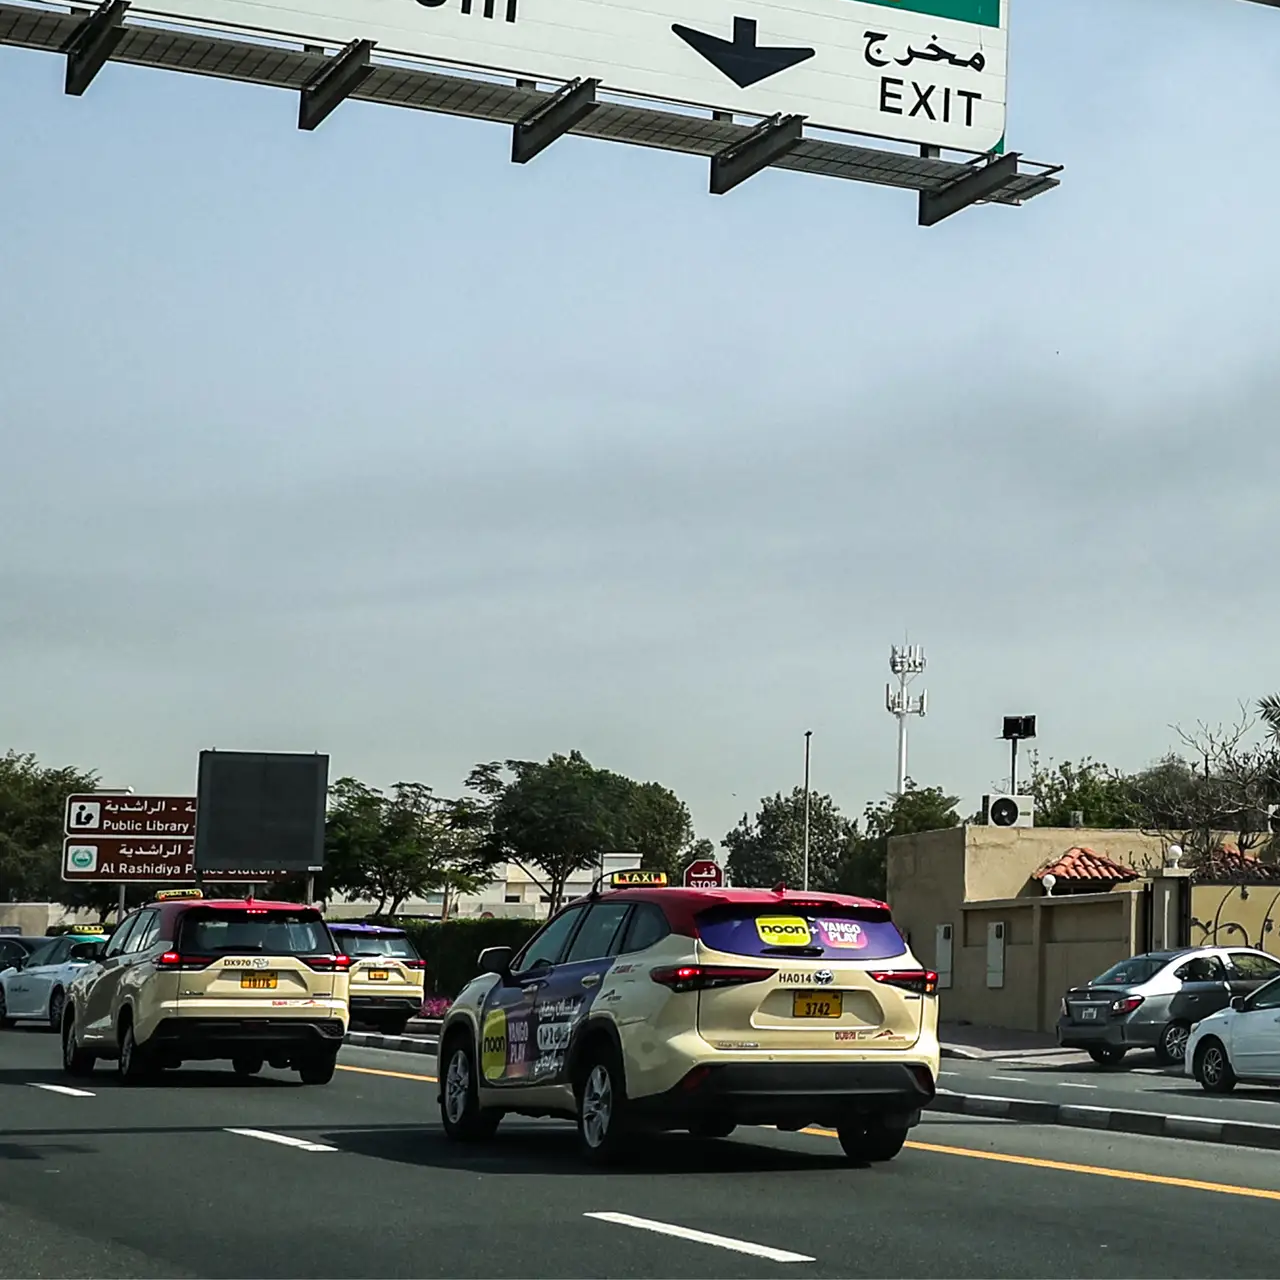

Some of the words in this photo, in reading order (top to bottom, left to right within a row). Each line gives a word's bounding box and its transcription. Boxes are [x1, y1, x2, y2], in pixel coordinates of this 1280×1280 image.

[862, 30, 986, 73] مخرج
[879, 75, 983, 128] EXIT
[104, 799, 166, 815] الراشدية
[102, 820, 142, 831] Public
[145, 820, 190, 834] Library
[118, 843, 182, 858] الراشدية
[100, 862, 115, 874] Al
[120, 862, 181, 876] Rashidiya
[690, 865, 717, 878] قف
[623, 873, 655, 883] TAXI
[760, 924, 806, 934] noon
[820, 921, 861, 934] YANGO
[828, 932, 859, 943] PLAY
[223, 958, 251, 967] DX970
[778, 973, 812, 984] HA014
[806, 1002, 831, 1016] 3742
[508, 1021, 529, 1042] YANGO
[484, 1036, 506, 1052] noon
[510, 1042, 527, 1063] PLAY
